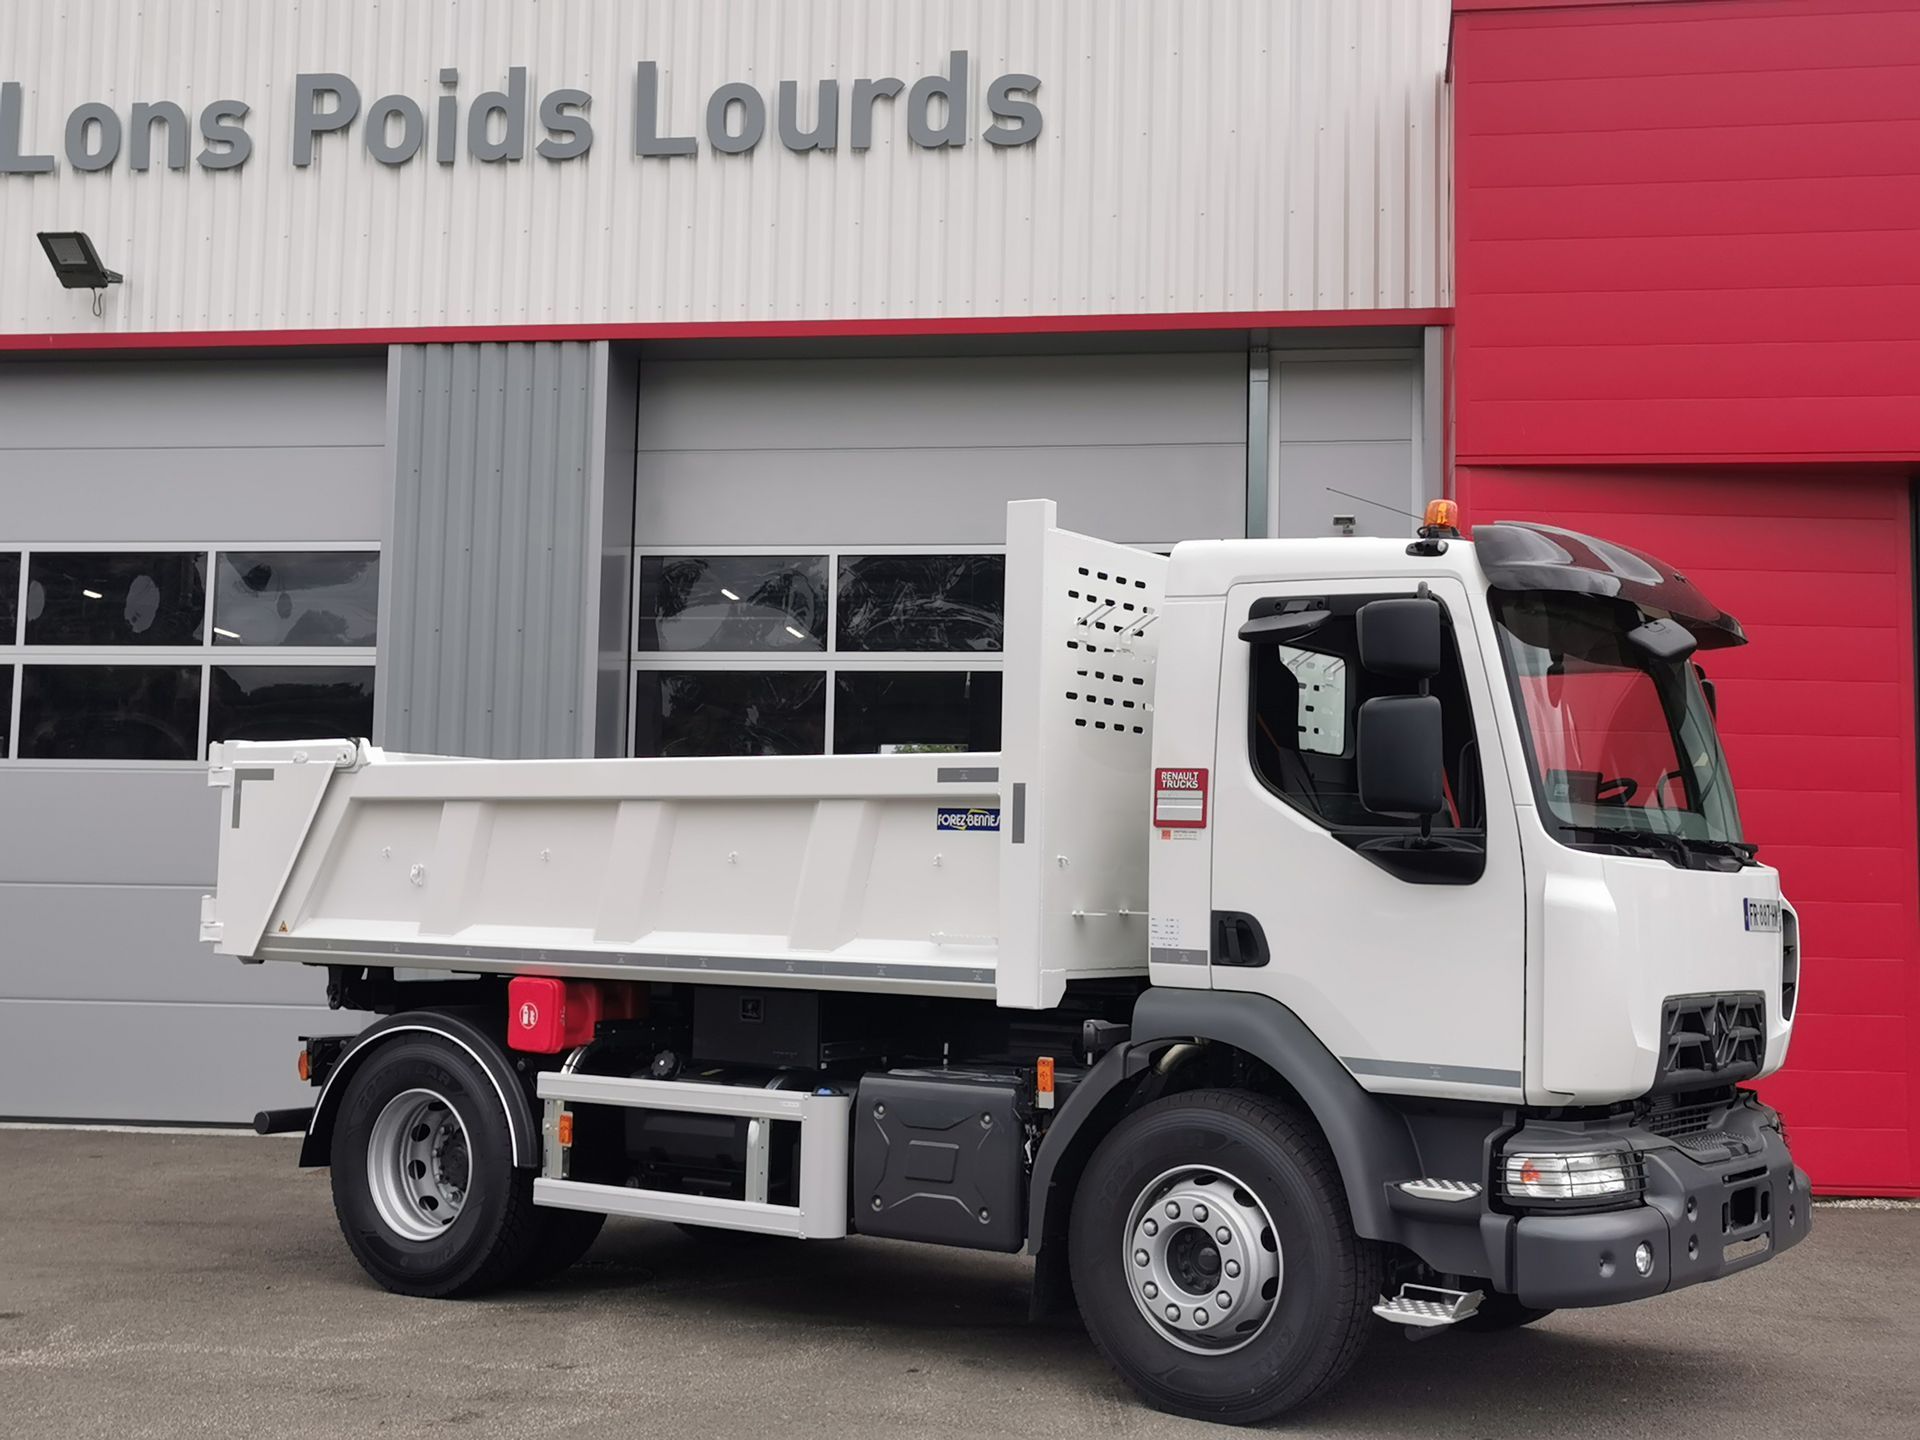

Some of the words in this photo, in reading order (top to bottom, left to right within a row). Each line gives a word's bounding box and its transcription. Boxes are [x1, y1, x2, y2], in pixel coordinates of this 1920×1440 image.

[0, 82, 252, 172] Lons
[292, 66, 594, 166] Poids
[636, 50, 1043, 156] Lourds
[1161, 771, 1199, 780] RENAULT
[1161, 779, 1199, 789] TRUCKS
